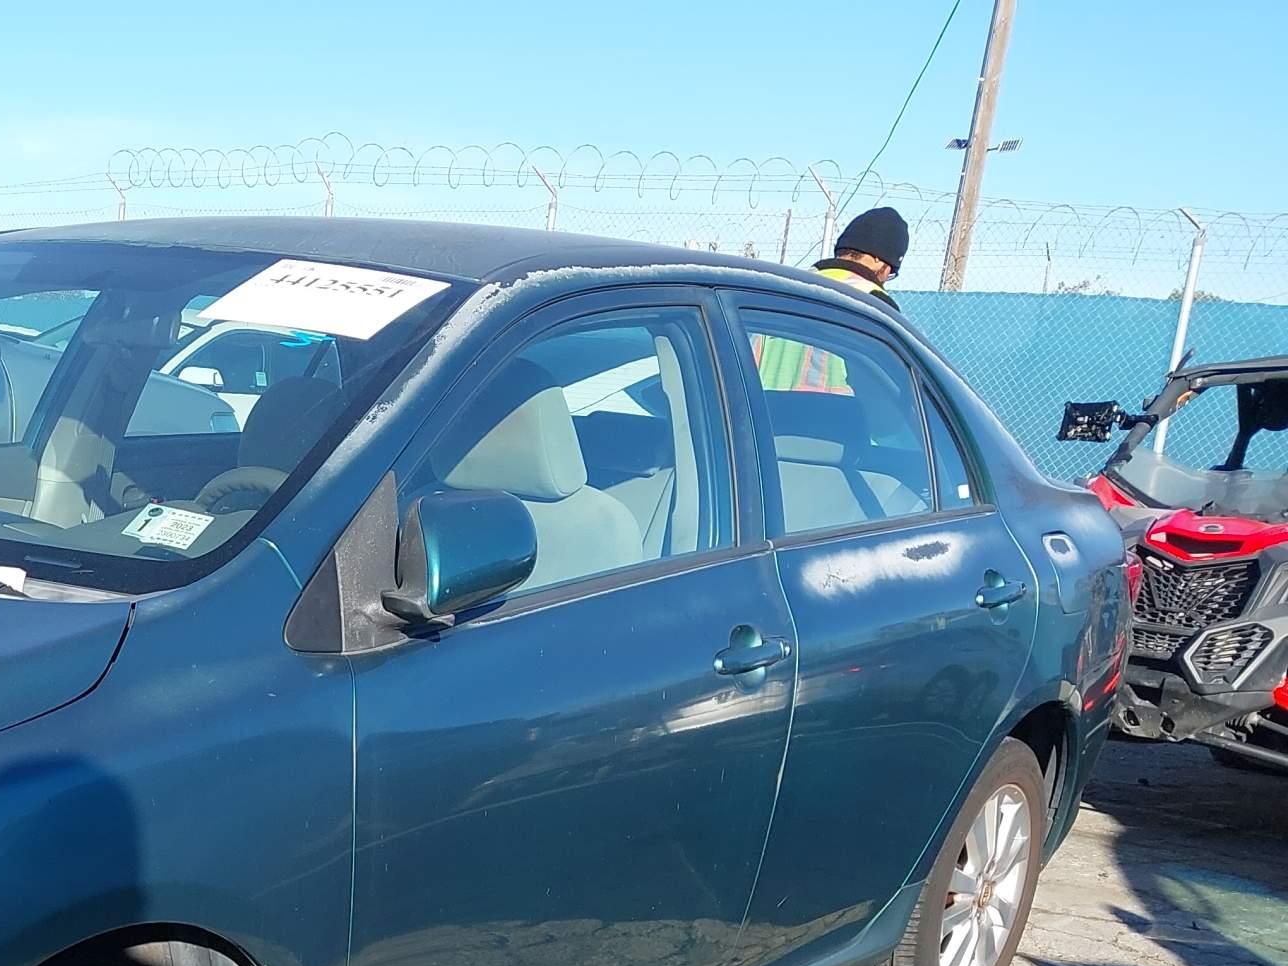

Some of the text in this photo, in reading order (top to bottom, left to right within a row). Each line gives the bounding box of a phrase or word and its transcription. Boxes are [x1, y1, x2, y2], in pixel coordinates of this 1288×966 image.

[270, 274, 404, 298] 44125551
[137, 518, 152, 532] 1
[170, 521, 194, 532] 2023
